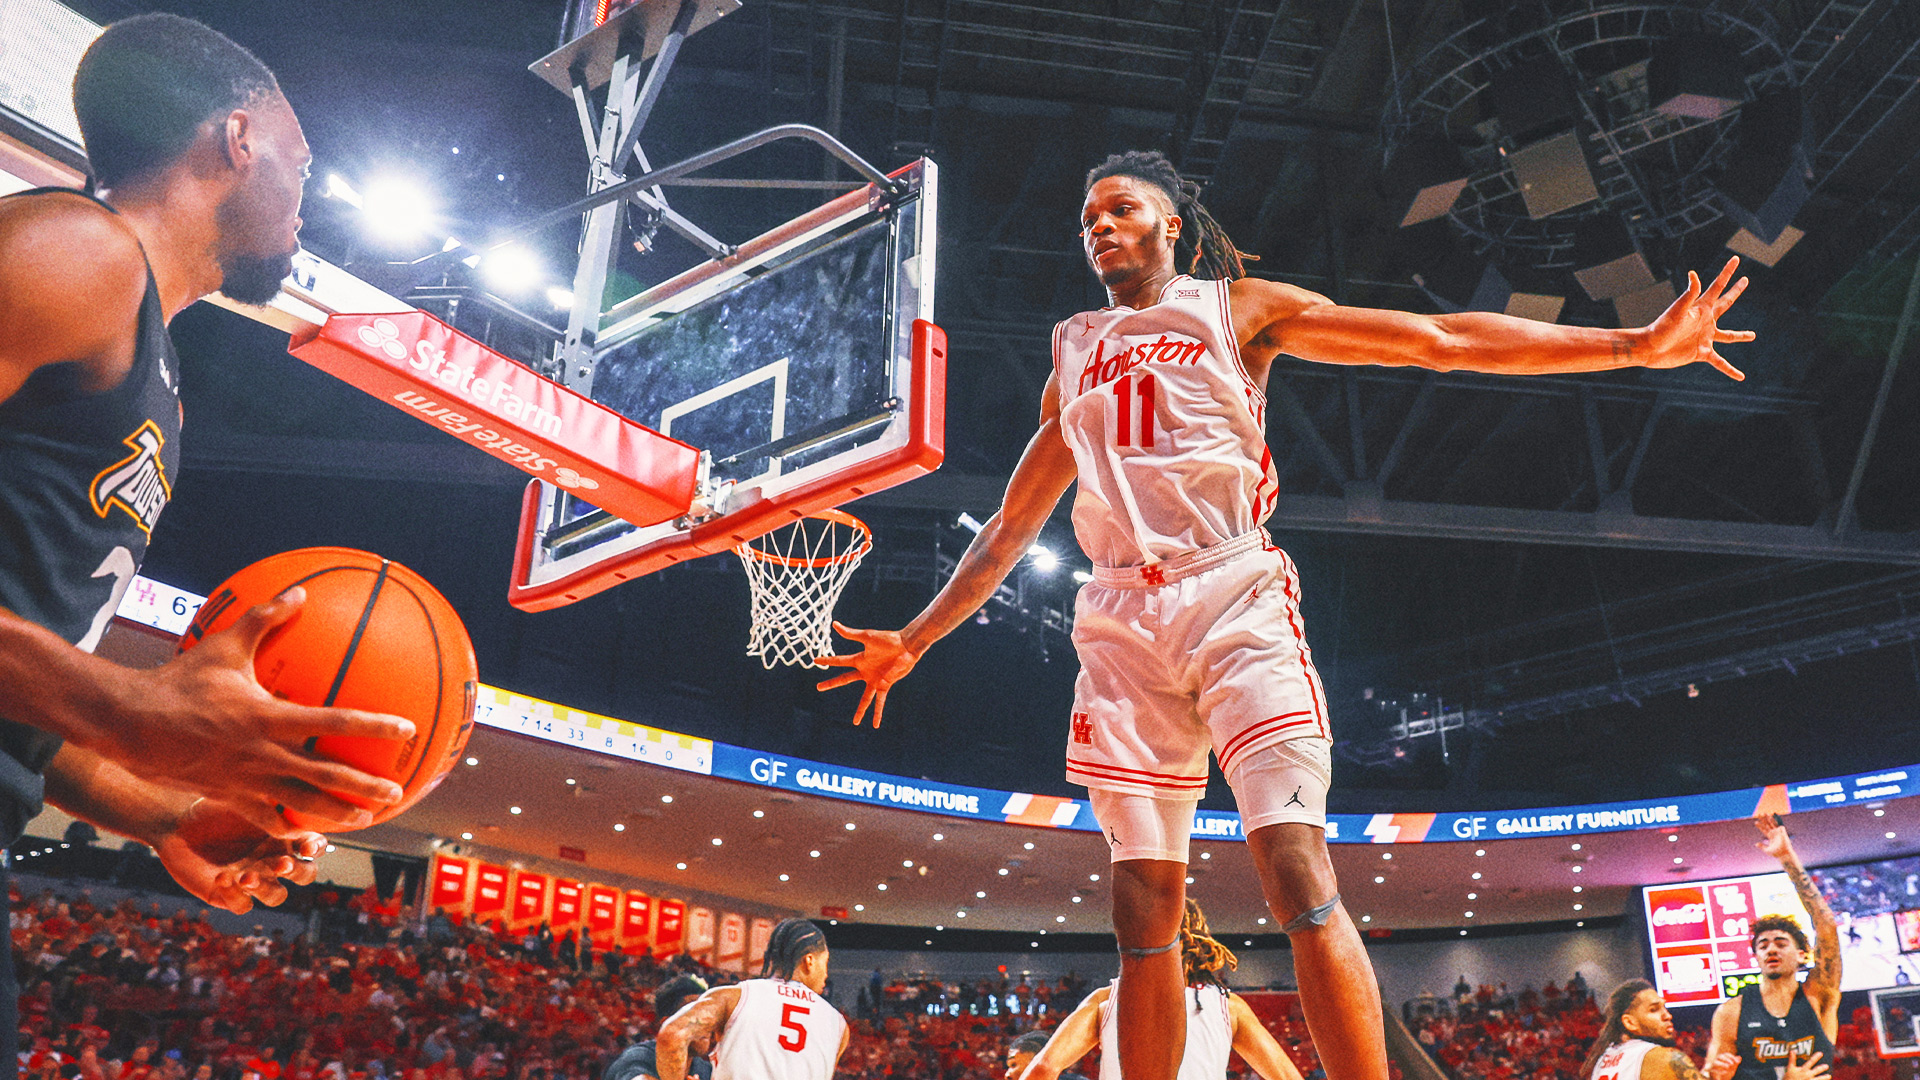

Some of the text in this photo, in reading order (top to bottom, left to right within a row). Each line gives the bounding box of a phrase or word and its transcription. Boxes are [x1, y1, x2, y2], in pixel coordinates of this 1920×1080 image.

[1078, 335, 1206, 396] Houston
[1113, 374, 1155, 448] 11
[98, 430, 168, 533] TOWS
[567, 728, 584, 741] 33
[605, 737, 613, 748] 8
[632, 743, 647, 755] 16
[696, 756, 704, 767] 9
[750, 757, 980, 814] GF GALLERY FURNITURE
[1189, 816, 1239, 836] LLERY
[1453, 805, 1681, 838] GF GALLERY FURNITURE
[778, 1003, 810, 1053] 5
